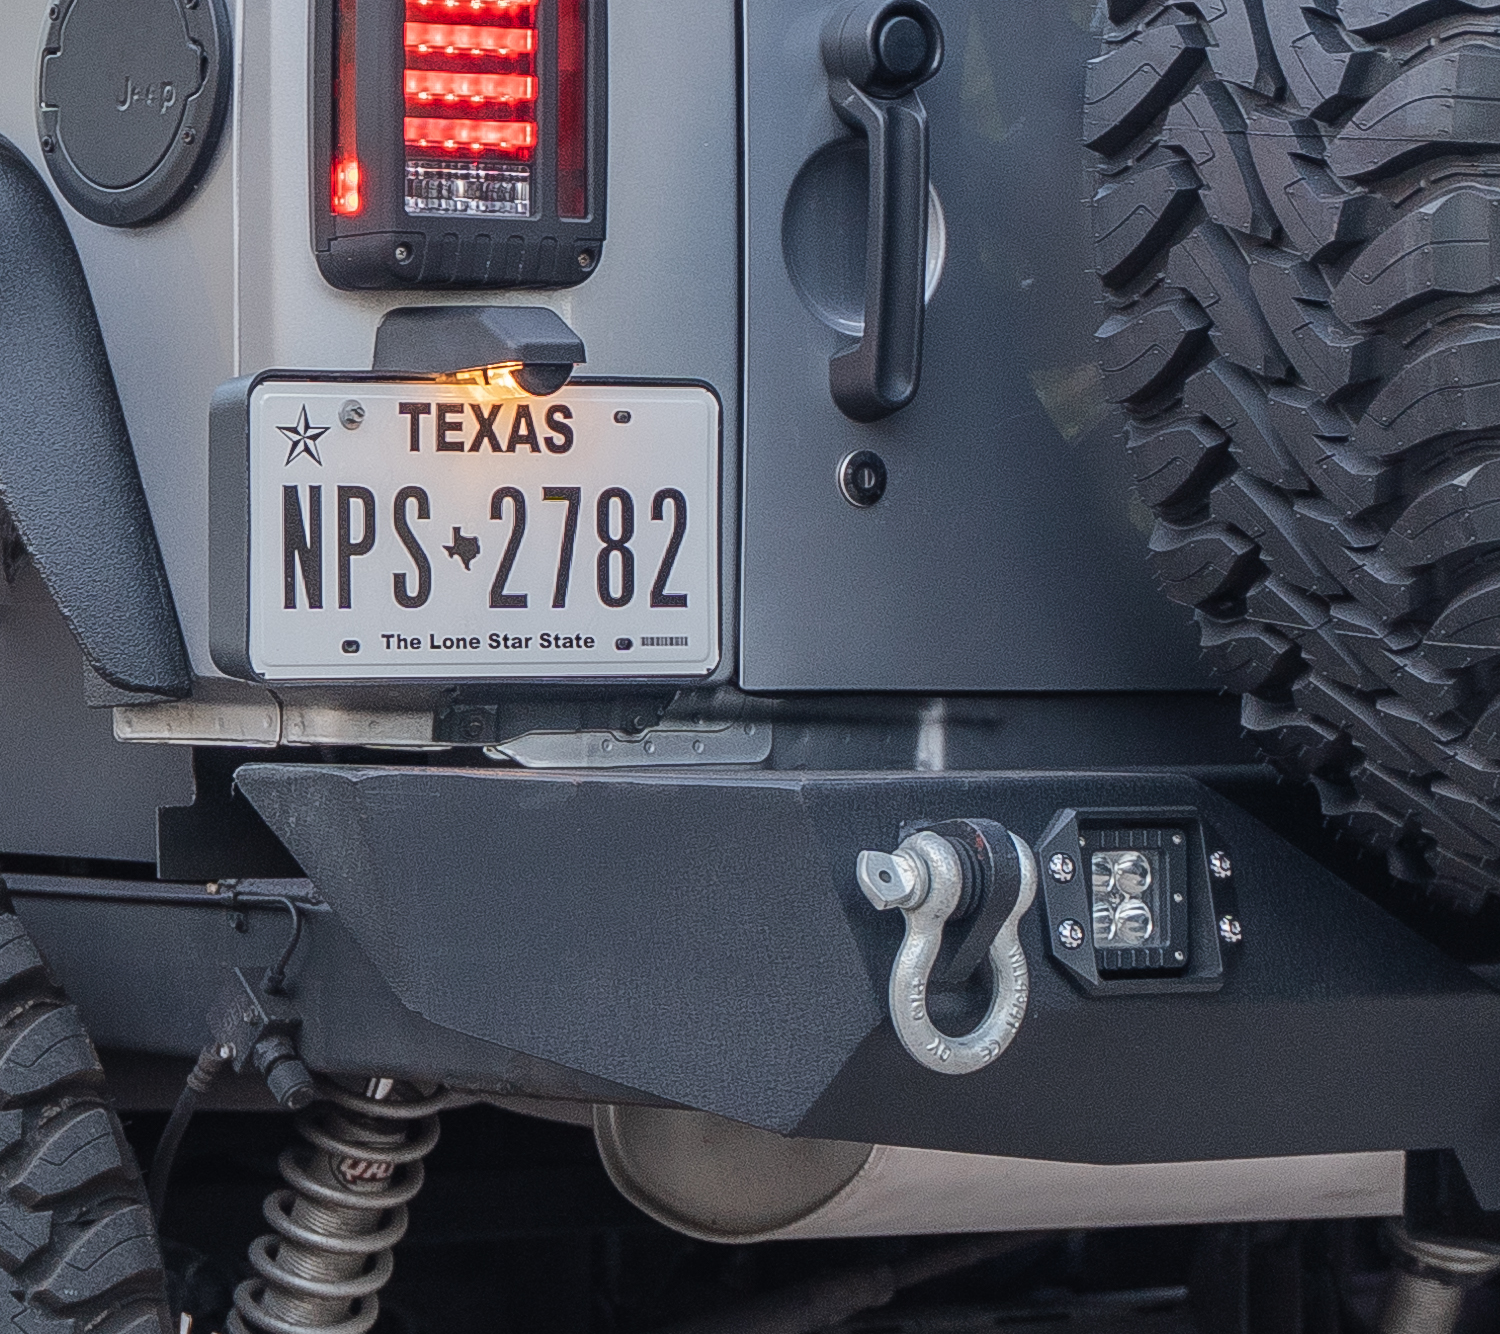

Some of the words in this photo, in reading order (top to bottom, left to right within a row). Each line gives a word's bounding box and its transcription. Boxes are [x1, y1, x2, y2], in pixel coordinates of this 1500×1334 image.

[116, 75, 177, 115] Jeep
[399, 402, 574, 454] TEXAS
[282, 485, 432, 609] NPS
[489, 486, 688, 609] 2782
[381, 633, 422, 650] The
[429, 634, 480, 650] Lone
[488, 633, 532, 650] Star
[539, 633, 596, 650] State
